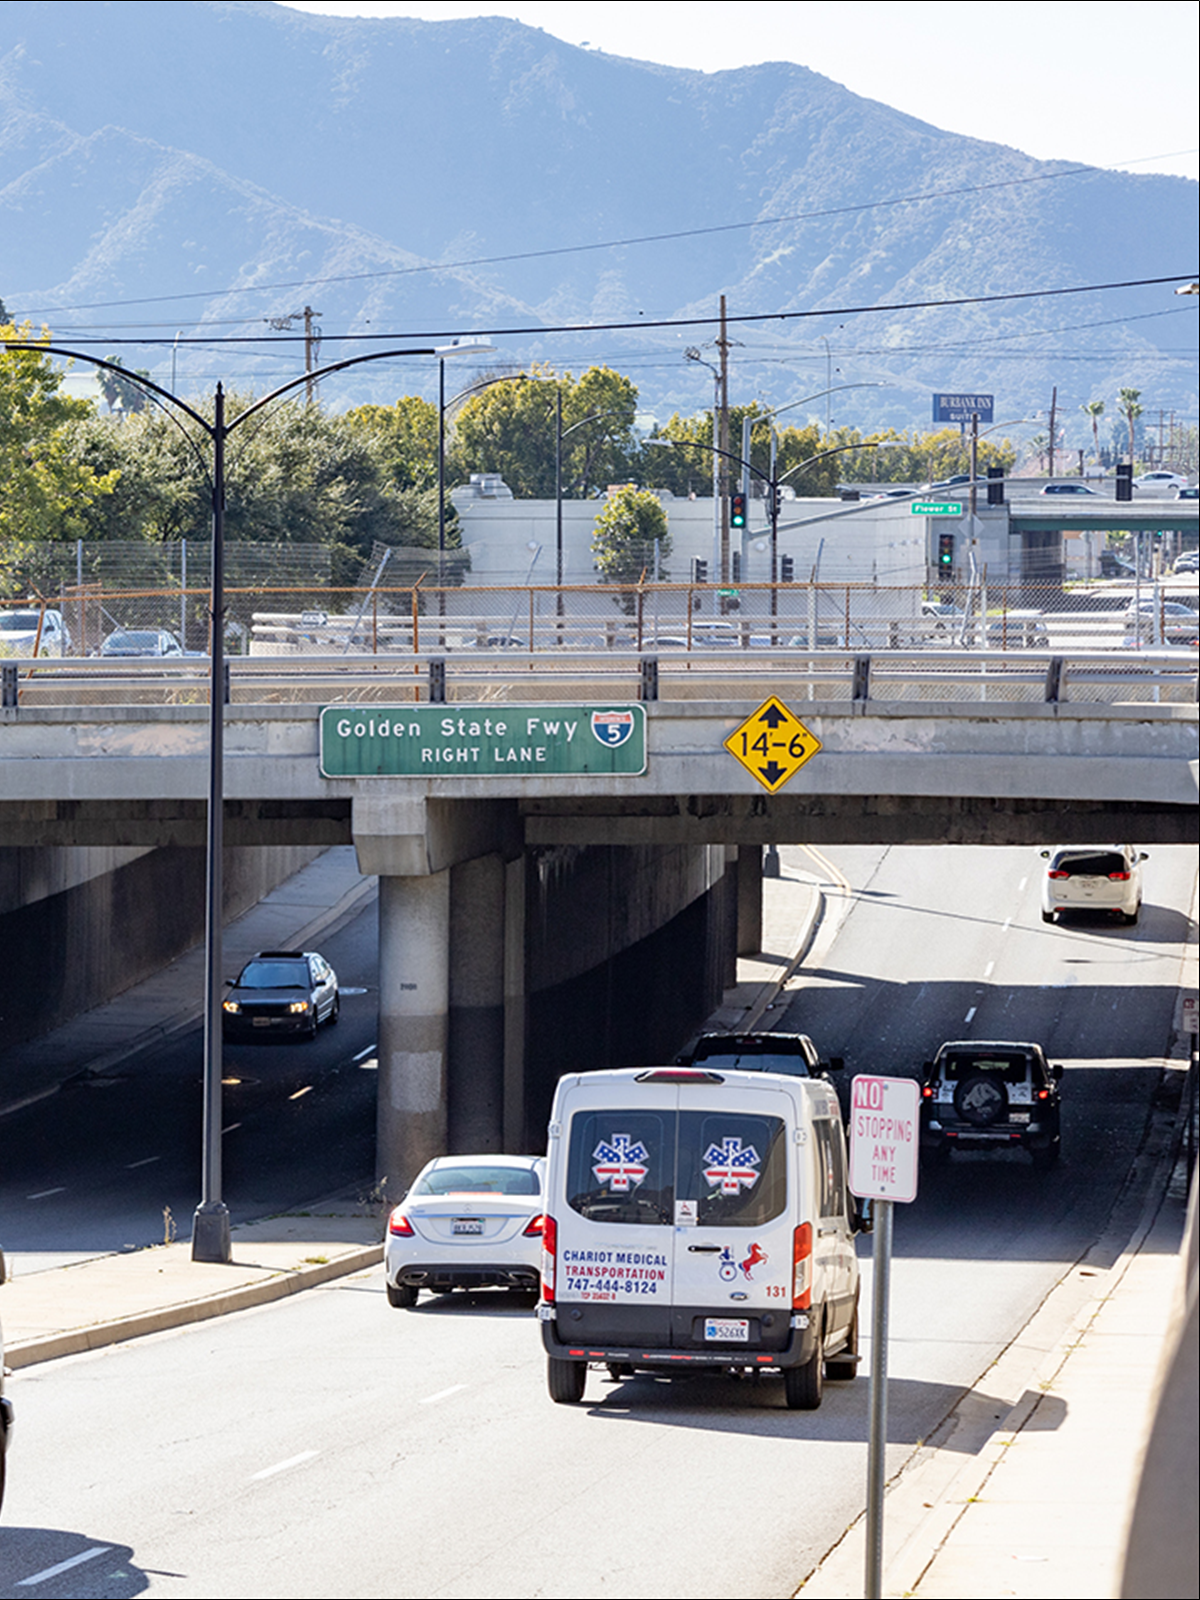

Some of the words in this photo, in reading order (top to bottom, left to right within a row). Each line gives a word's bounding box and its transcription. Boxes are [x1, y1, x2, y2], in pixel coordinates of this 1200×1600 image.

[337, 719, 420, 737] Golden
[441, 718, 507, 736] State
[527, 718, 577, 742] Fwy
[608, 724, 621, 743] 5
[422, 748, 480, 762] RIGHT
[495, 747, 546, 762] LANE
[856, 1081, 881, 1108] NO
[857, 1115, 912, 1142] STOPPING
[872, 1145, 897, 1162] ANY
[871, 1165, 896, 1184] TIME
[563, 1250, 613, 1263] CHARIOT
[616, 1252, 668, 1267] MEDICAL
[564, 1265, 666, 1281] TRANSPORTATION
[566, 1277, 657, 1294] 747-444-8124
[765, 1286, 786, 1298] 131
